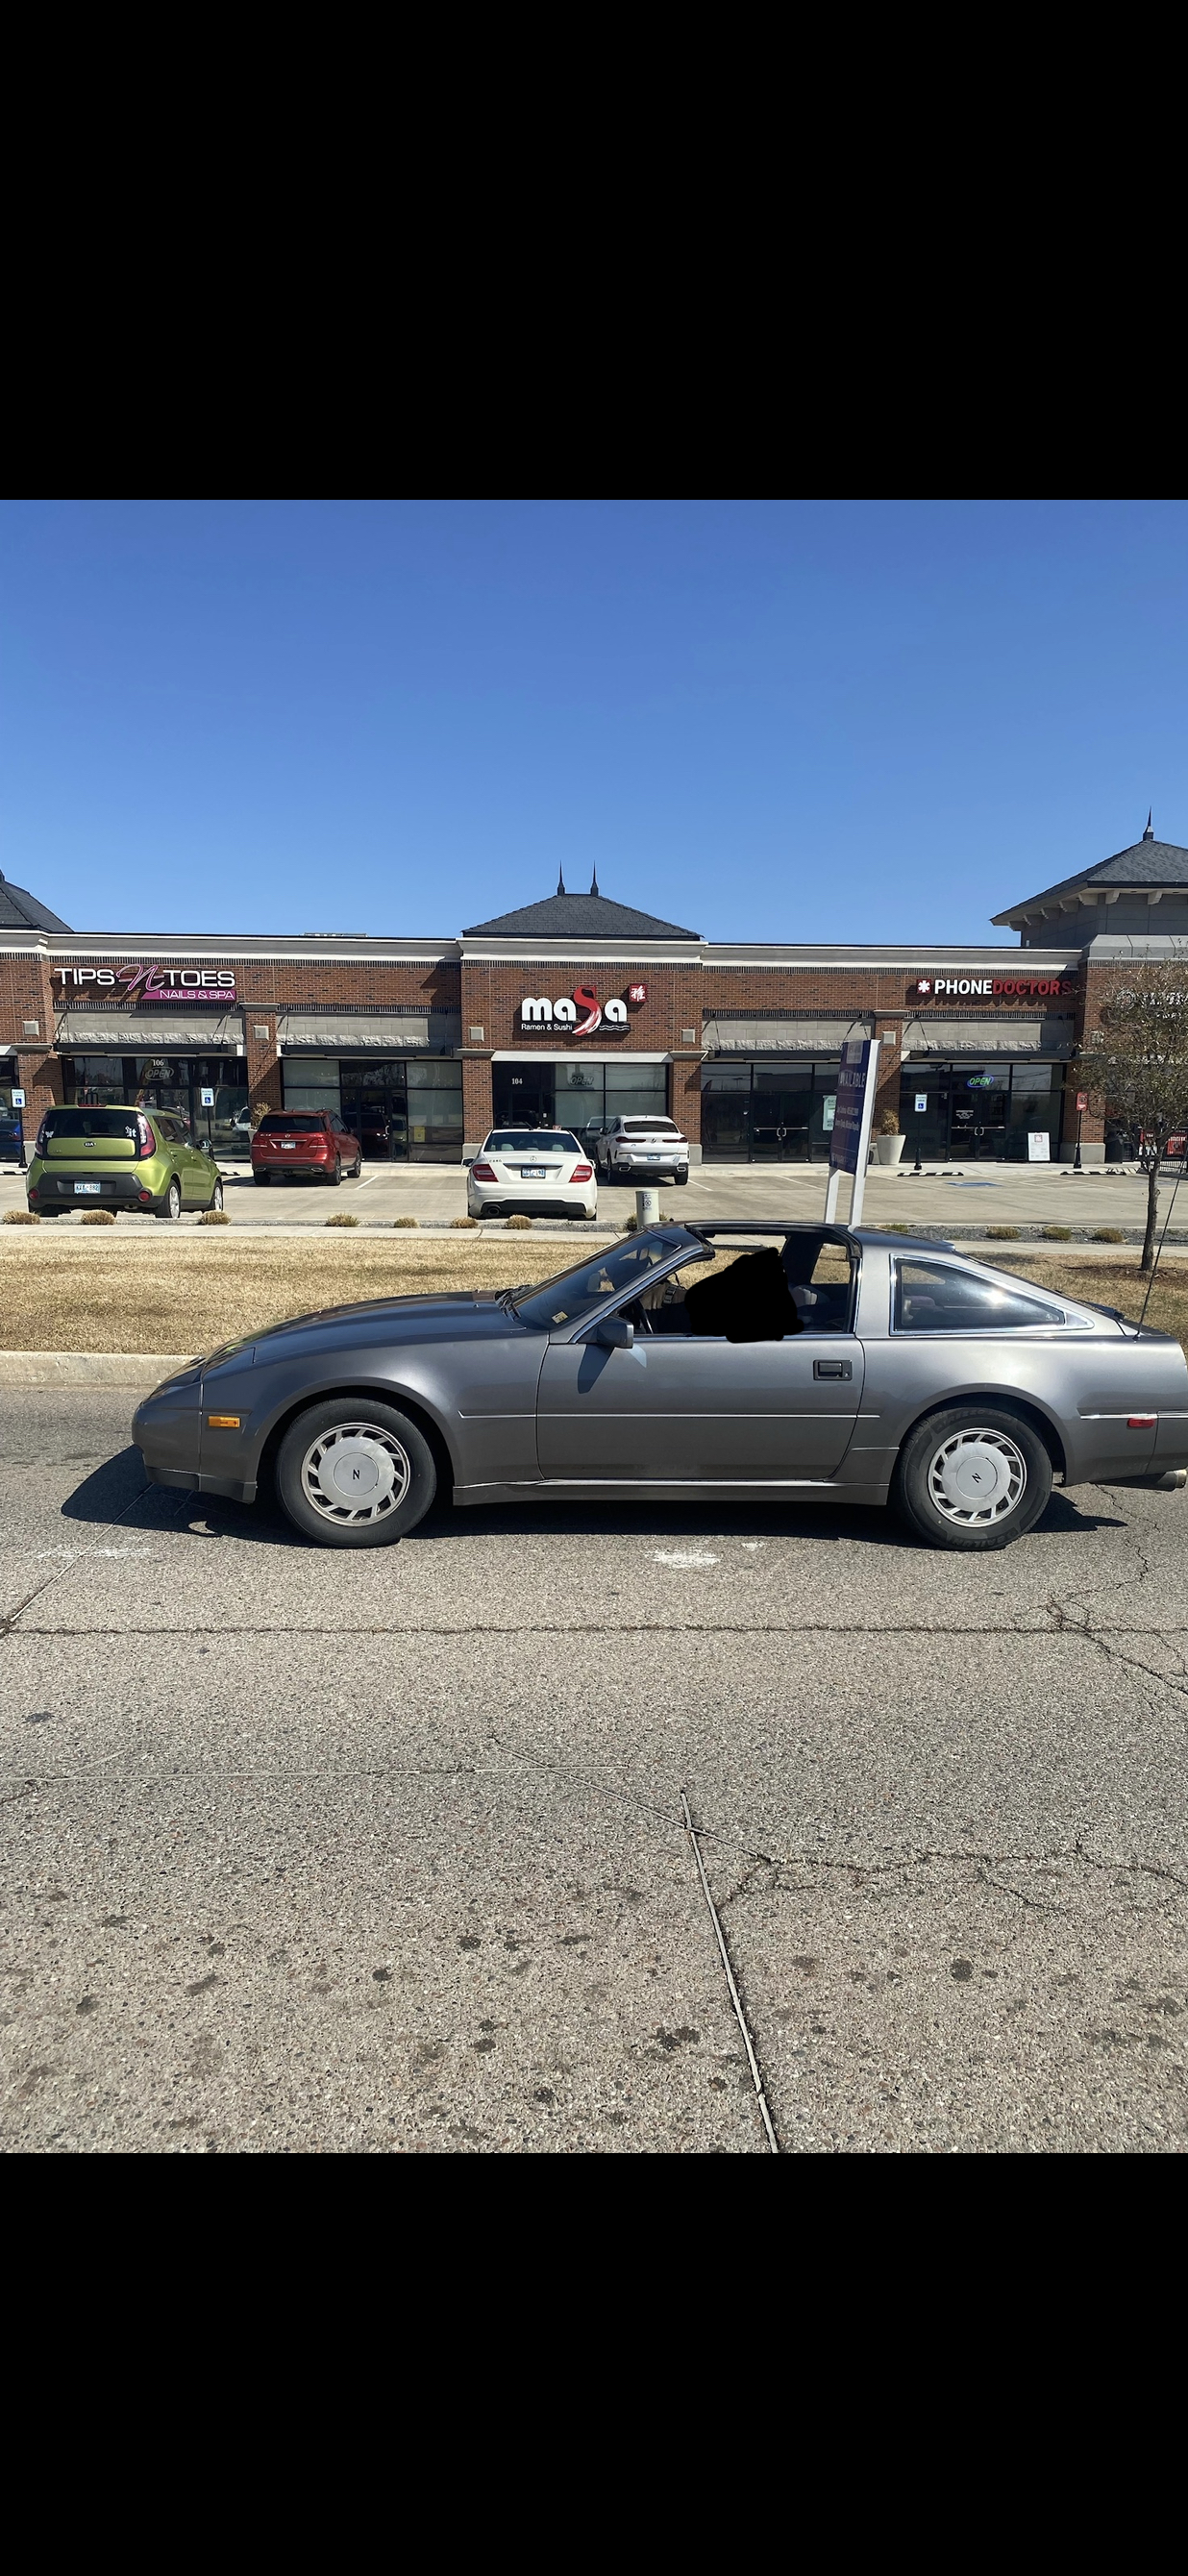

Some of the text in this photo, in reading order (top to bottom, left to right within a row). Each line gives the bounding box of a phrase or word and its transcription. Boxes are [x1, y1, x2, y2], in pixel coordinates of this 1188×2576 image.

[55, 968, 115, 985] TIPS
[163, 969, 235, 988] TOES
[160, 990, 235, 1000] NAILS & SPA
[521, 1023, 573, 1031] Ramen & Sushi
[147, 1069, 171, 1078] OPEN
[570, 1077, 595, 1085] OPEN
[969, 1077, 991, 1086] OPEN
